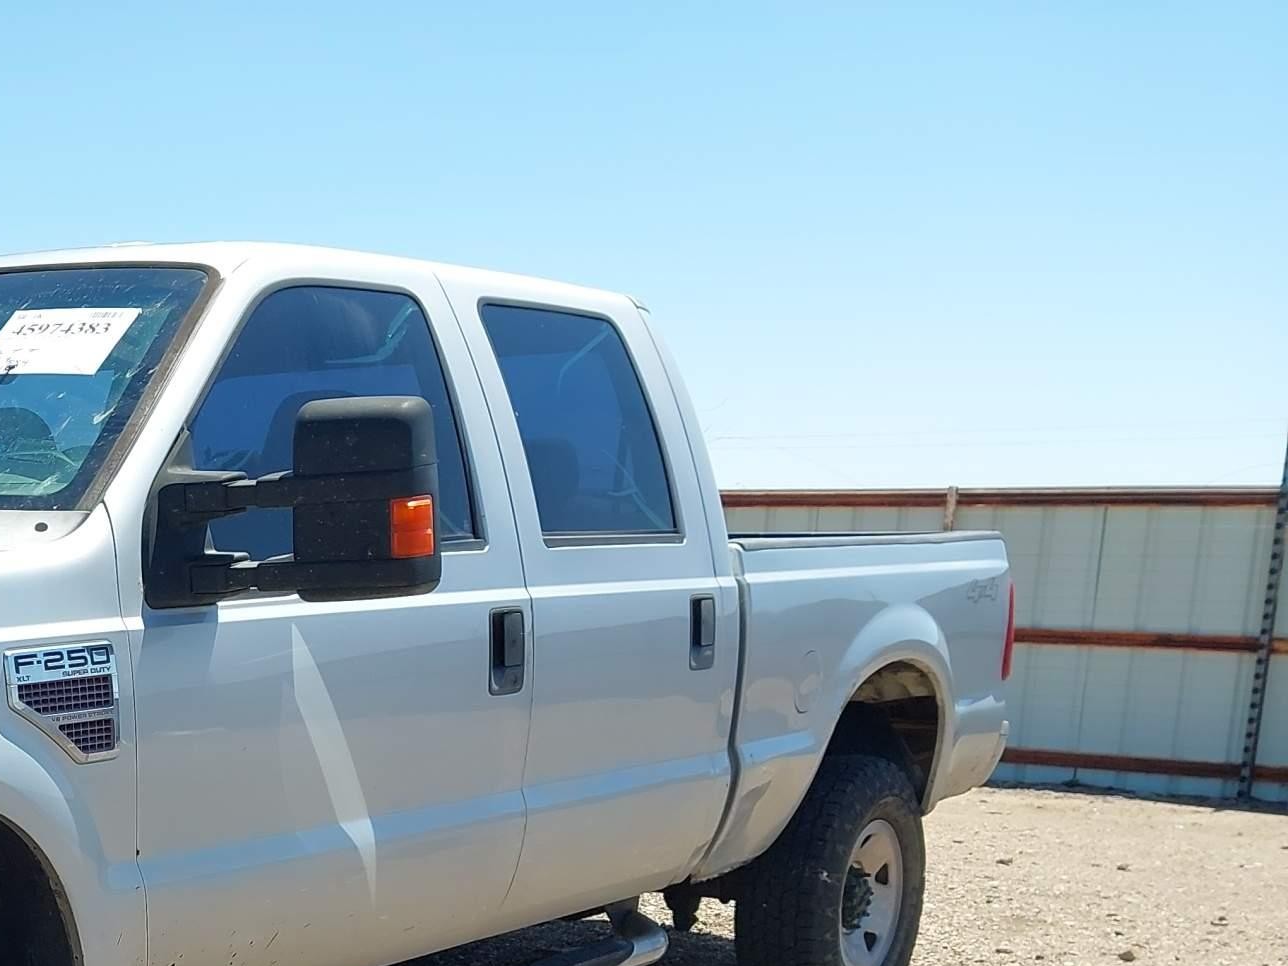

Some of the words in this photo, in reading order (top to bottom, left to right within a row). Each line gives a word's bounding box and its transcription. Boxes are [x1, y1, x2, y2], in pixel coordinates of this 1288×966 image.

[12, 322, 112, 336] 45974383
[14, 647, 110, 674] F-250
[62, 668, 89, 676] SUPER
[16, 675, 31, 683] XLT
[62, 713, 87, 721] POWER
